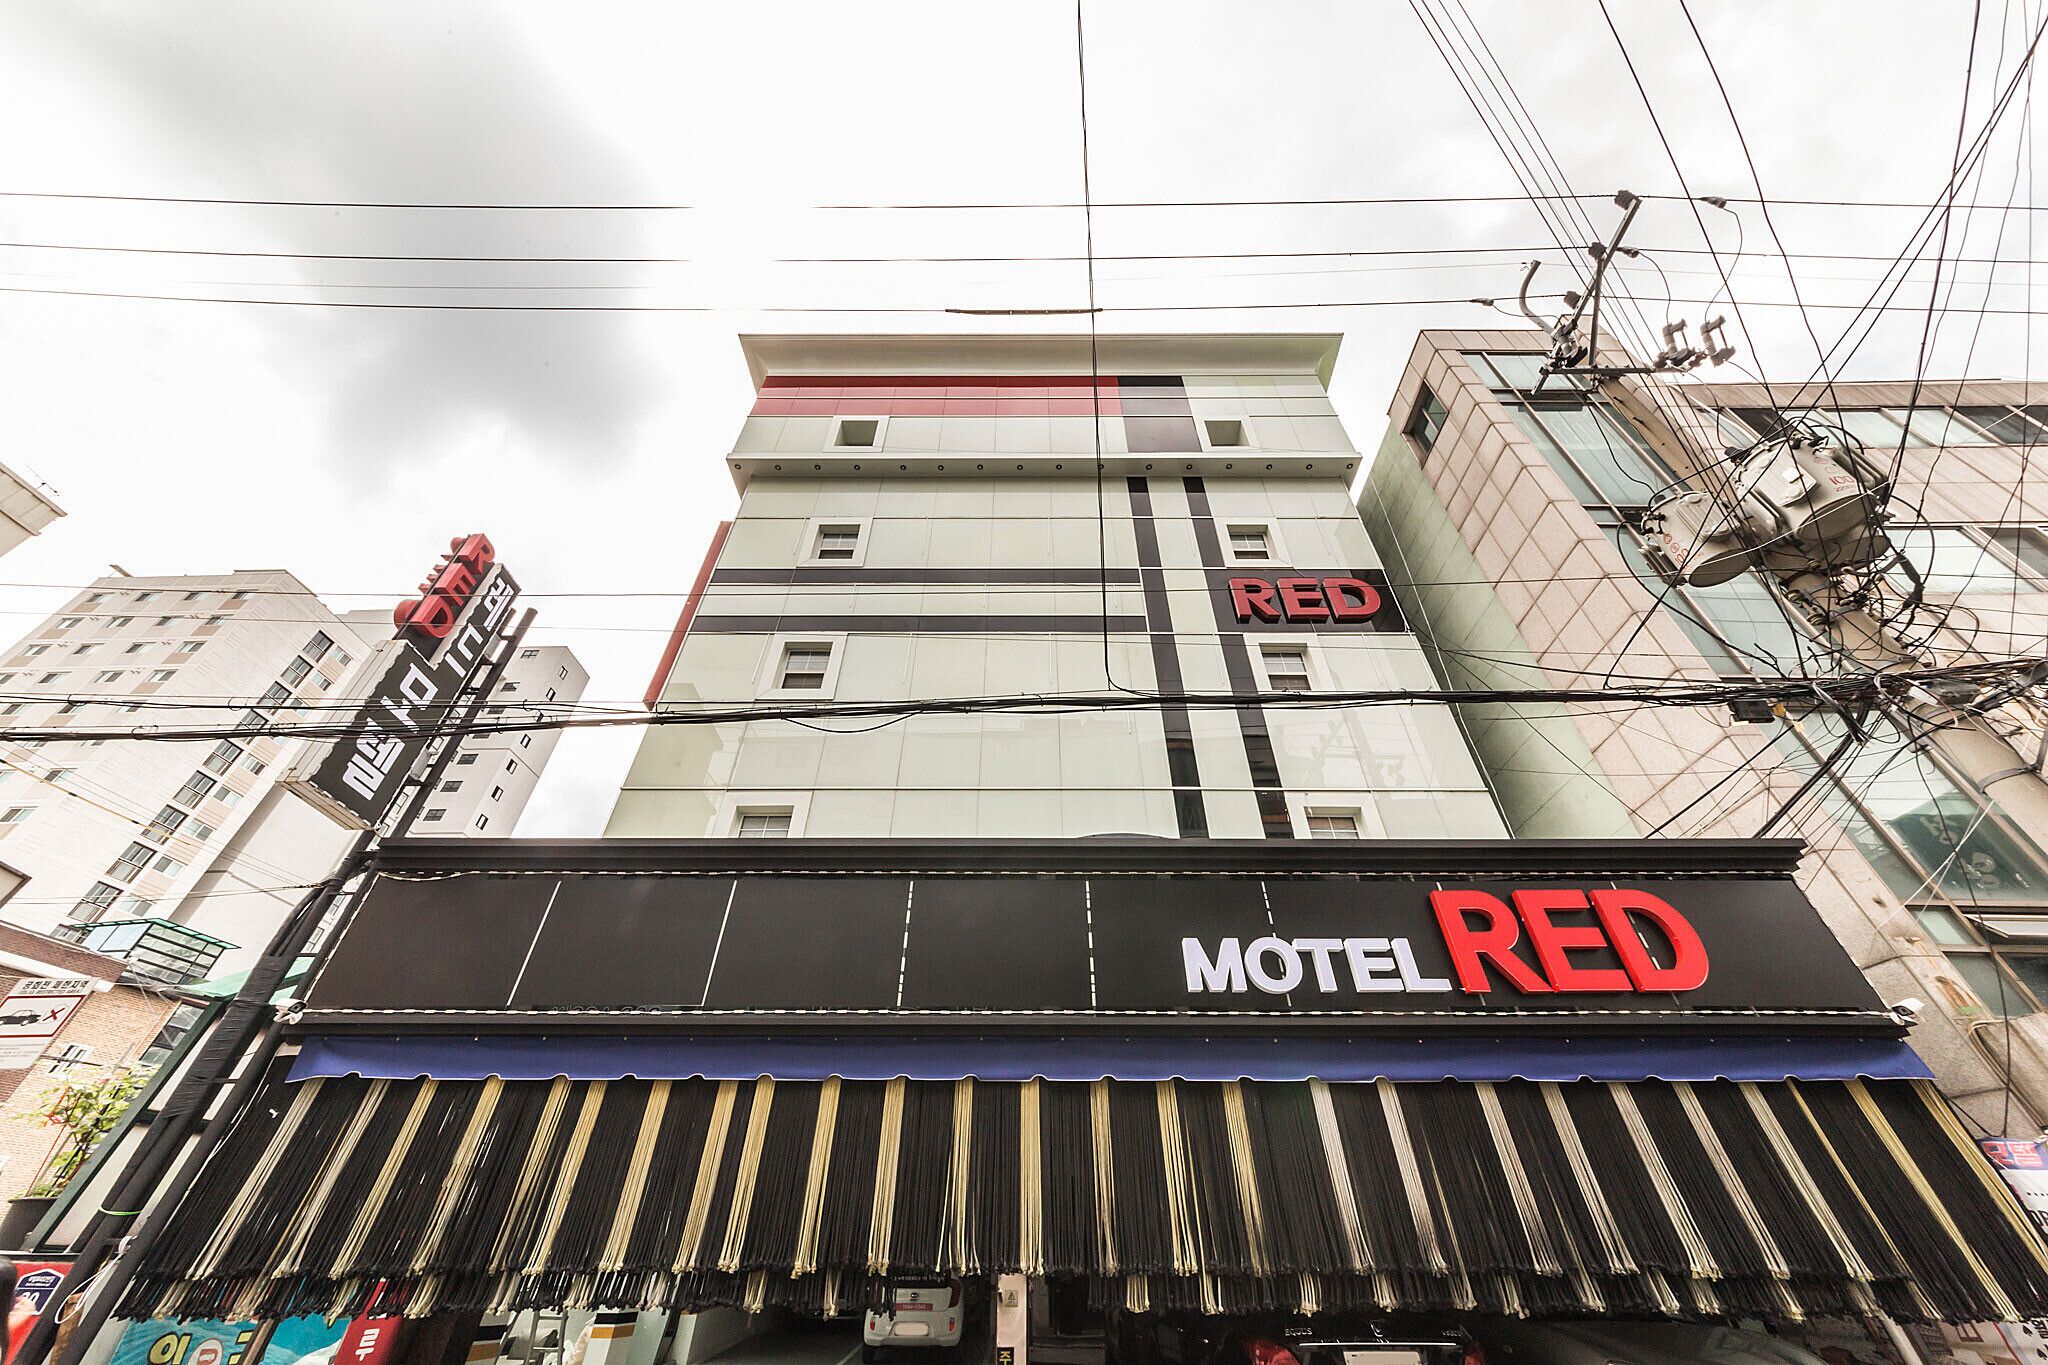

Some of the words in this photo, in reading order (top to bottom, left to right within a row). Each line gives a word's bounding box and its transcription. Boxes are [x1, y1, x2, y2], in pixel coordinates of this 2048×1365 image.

[409, 533, 495, 638] RED
[445, 577, 514, 678] 레드
[1228, 577, 1381, 624] RED
[343, 662, 438, 800] 모텔
[1182, 936, 1452, 995] MOTEL
[1429, 889, 1710, 994] RED
[1285, 1327, 1313, 1337] EQUUS
